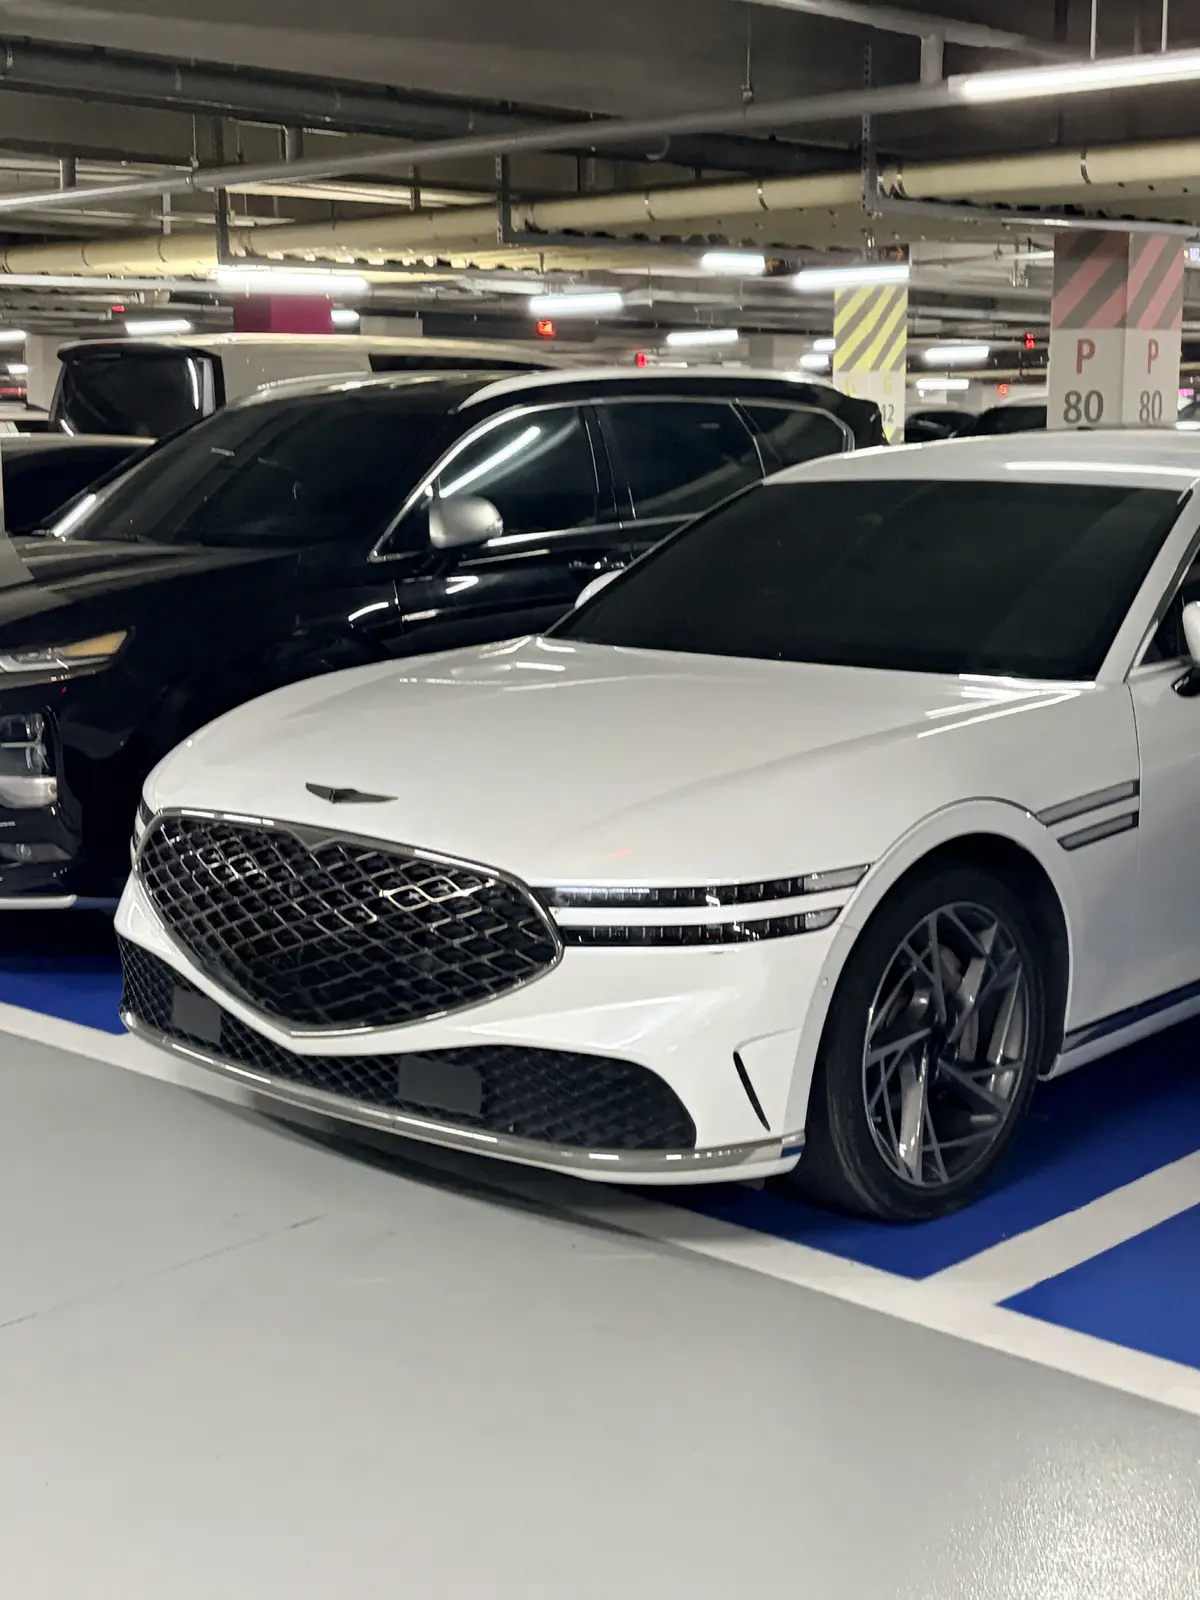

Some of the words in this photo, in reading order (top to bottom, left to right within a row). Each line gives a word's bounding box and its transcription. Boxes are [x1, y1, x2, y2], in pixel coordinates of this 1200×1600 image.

[1076, 338, 1096, 374] P
[1147, 338, 1159, 374] P
[881, 403, 895, 424] 12
[1063, 389, 1104, 424] 80
[1139, 390, 1163, 424] 80
